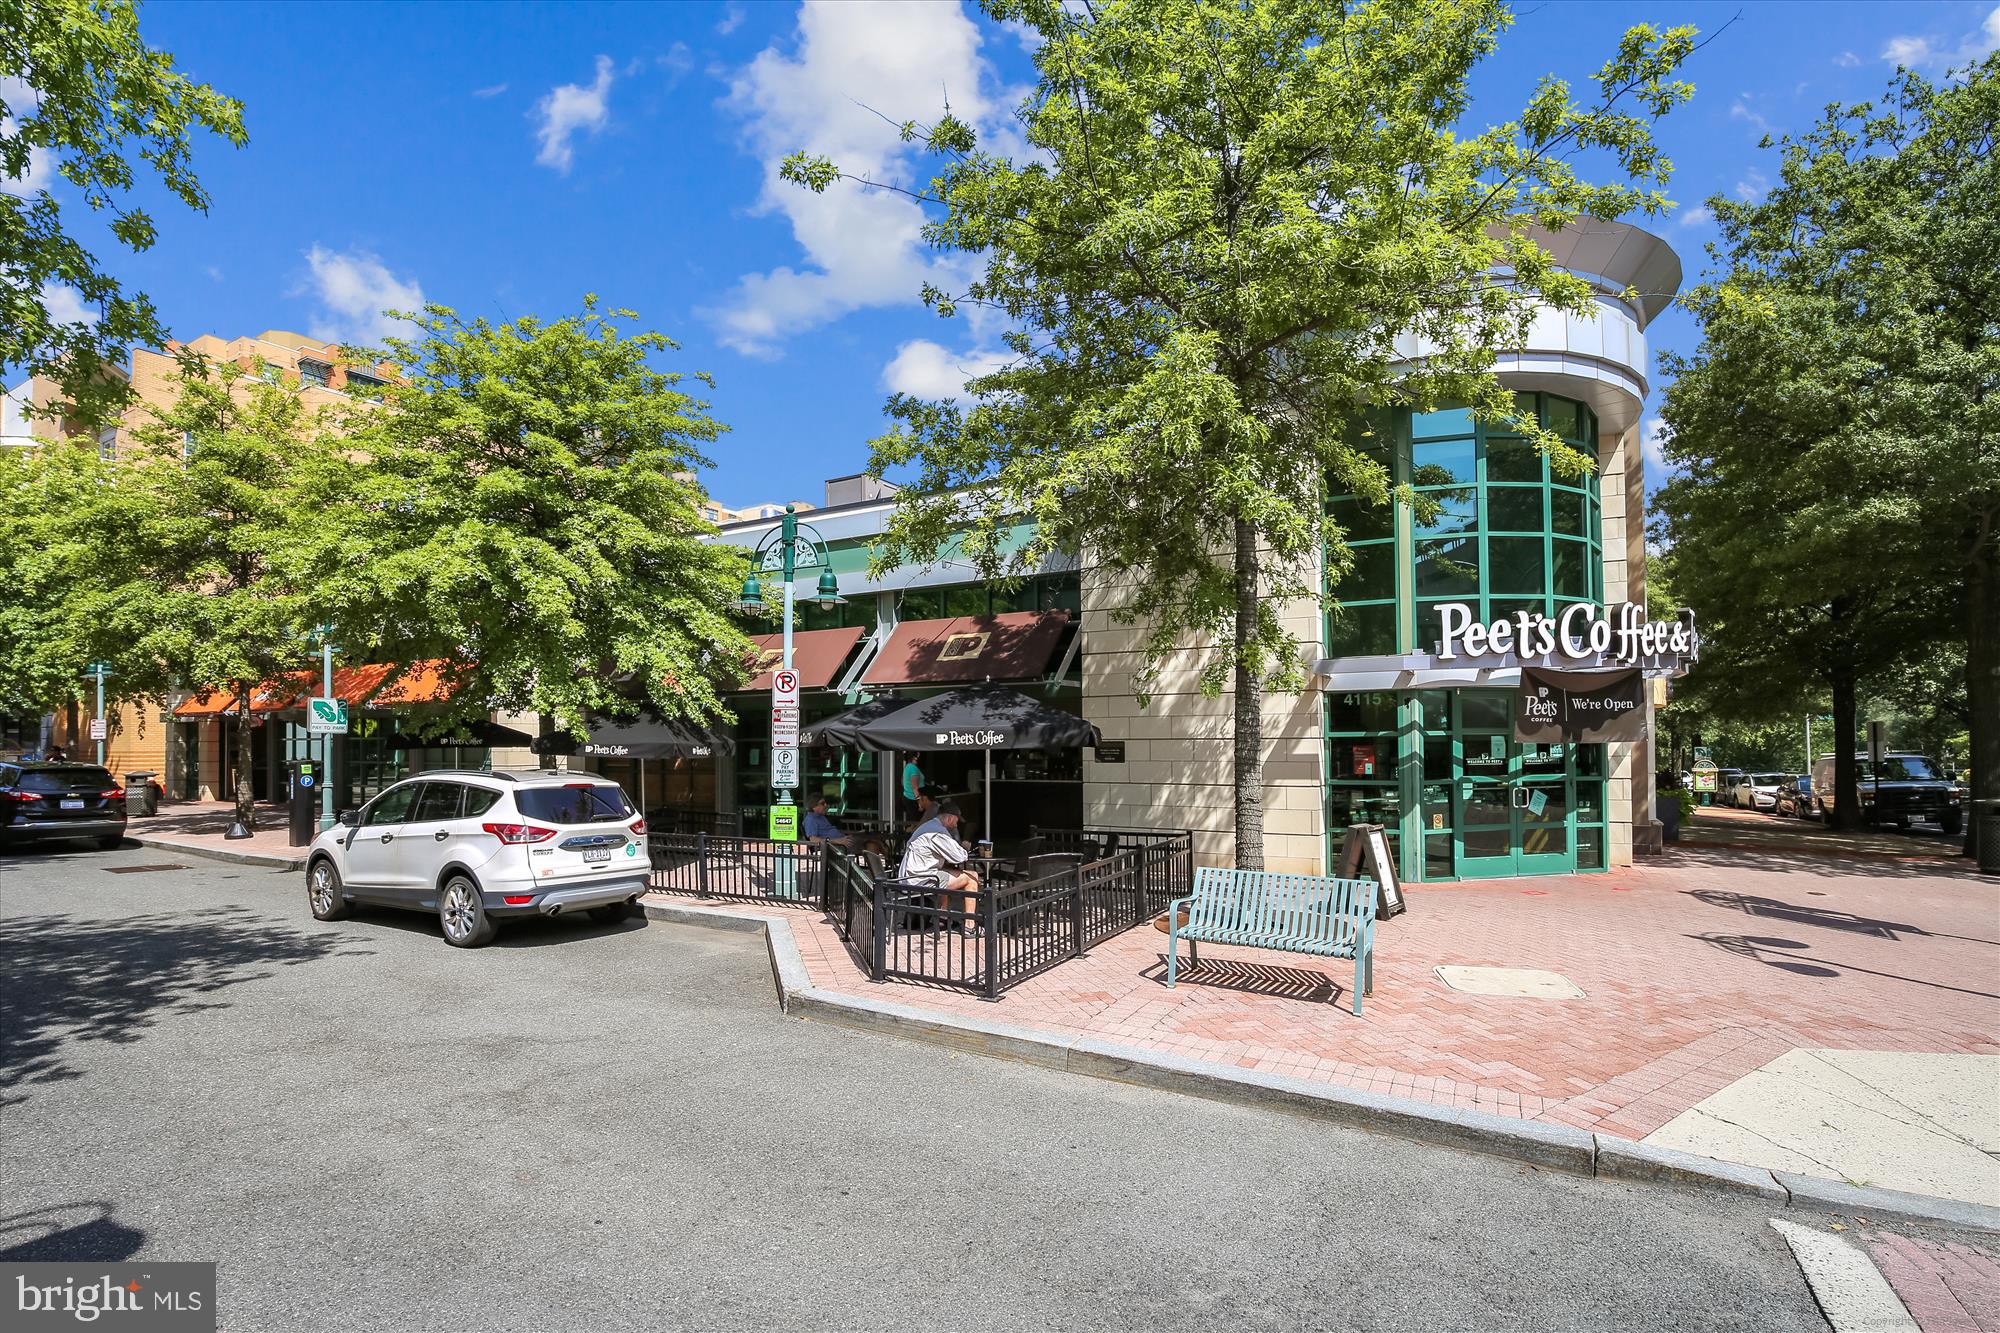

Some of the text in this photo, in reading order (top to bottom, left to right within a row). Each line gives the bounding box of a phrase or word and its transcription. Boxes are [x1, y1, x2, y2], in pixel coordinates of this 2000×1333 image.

[1433, 603, 1556, 659] Peet's
[1559, 601, 1668, 663] Coffee
[1343, 693, 1382, 706] 4115
[1524, 695, 1557, 717] Peet's
[1572, 698, 1634, 711] We're Open
[949, 730, 1004, 746] Peet's Coffee
[610, 744, 629, 755] Coffee
[782, 752, 789, 763] P
